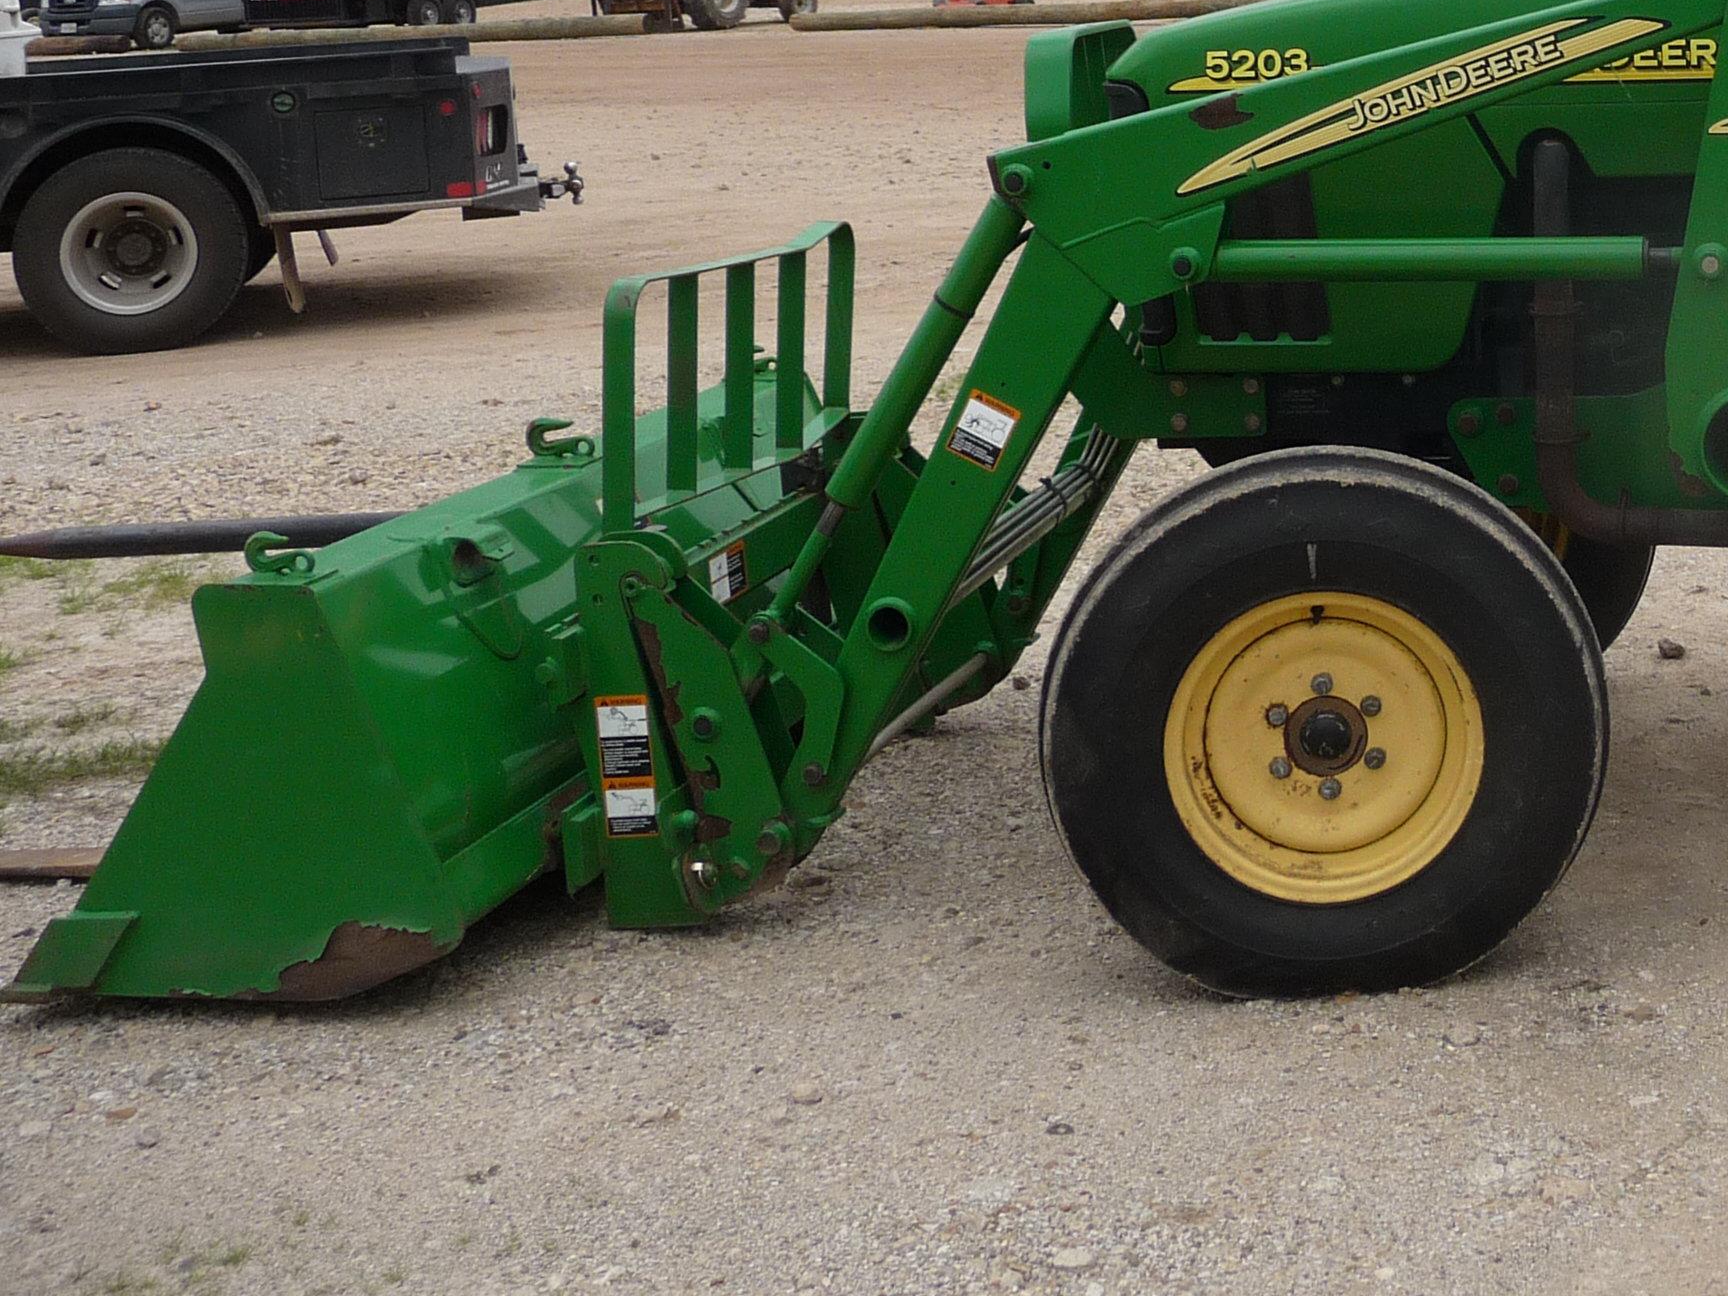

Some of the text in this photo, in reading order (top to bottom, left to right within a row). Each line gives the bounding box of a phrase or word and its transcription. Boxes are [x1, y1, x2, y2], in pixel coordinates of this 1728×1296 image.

[1204, 46, 1310, 80] 5203
[1348, 33, 1564, 132] JOHN DEERE
